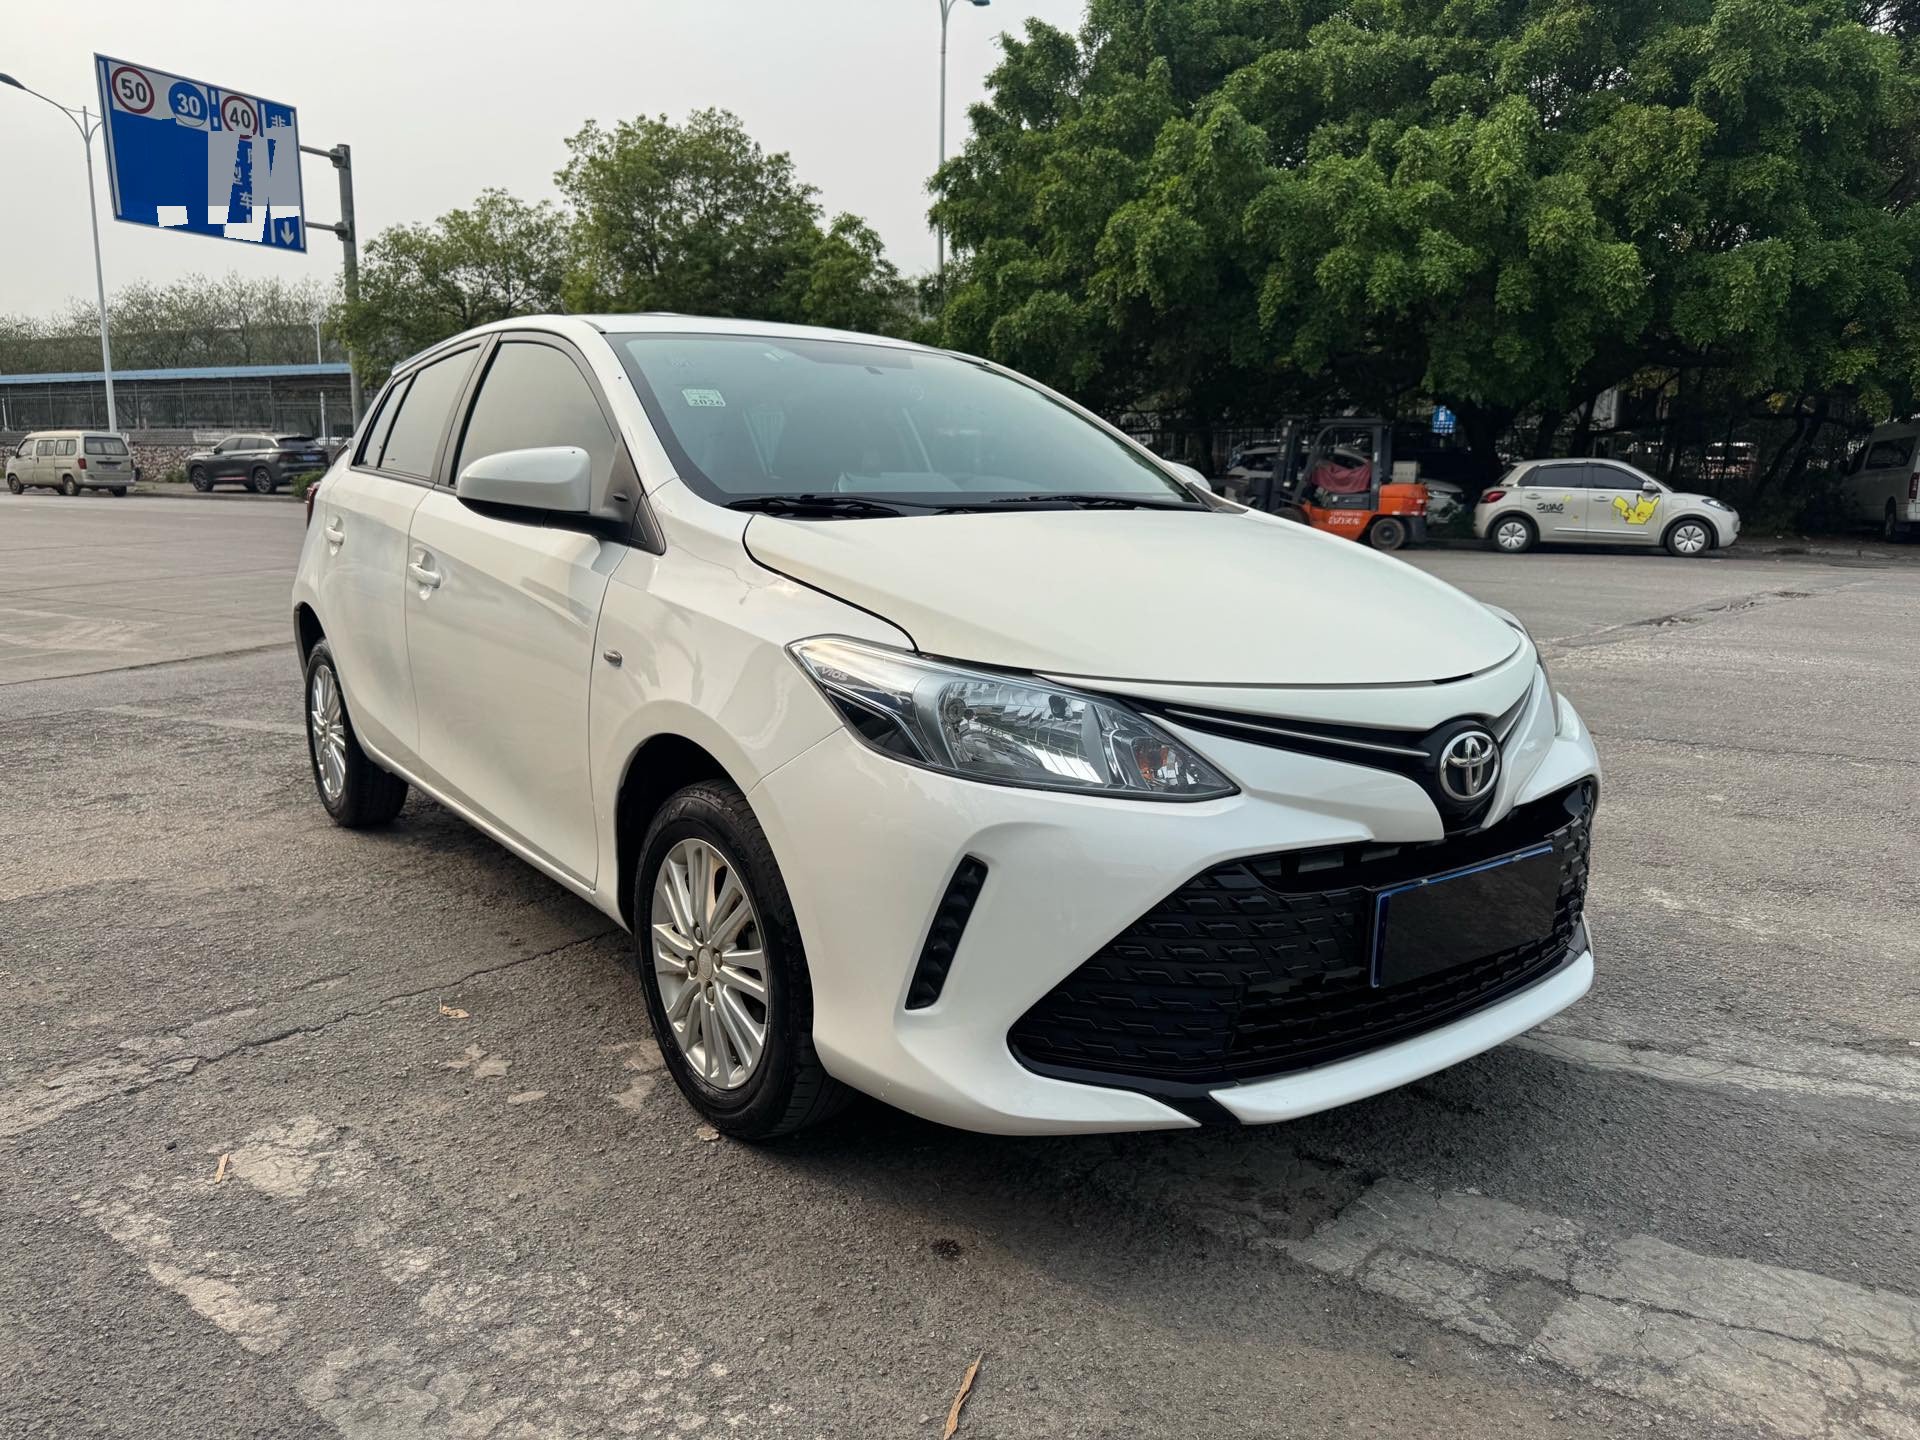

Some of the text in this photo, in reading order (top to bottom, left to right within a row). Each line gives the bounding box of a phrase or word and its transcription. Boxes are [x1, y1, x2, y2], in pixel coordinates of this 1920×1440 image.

[121, 77, 147, 103] 50
[176, 93, 201, 116] 30
[229, 107, 251, 129] 40
[822, 665, 848, 680] VIOS
